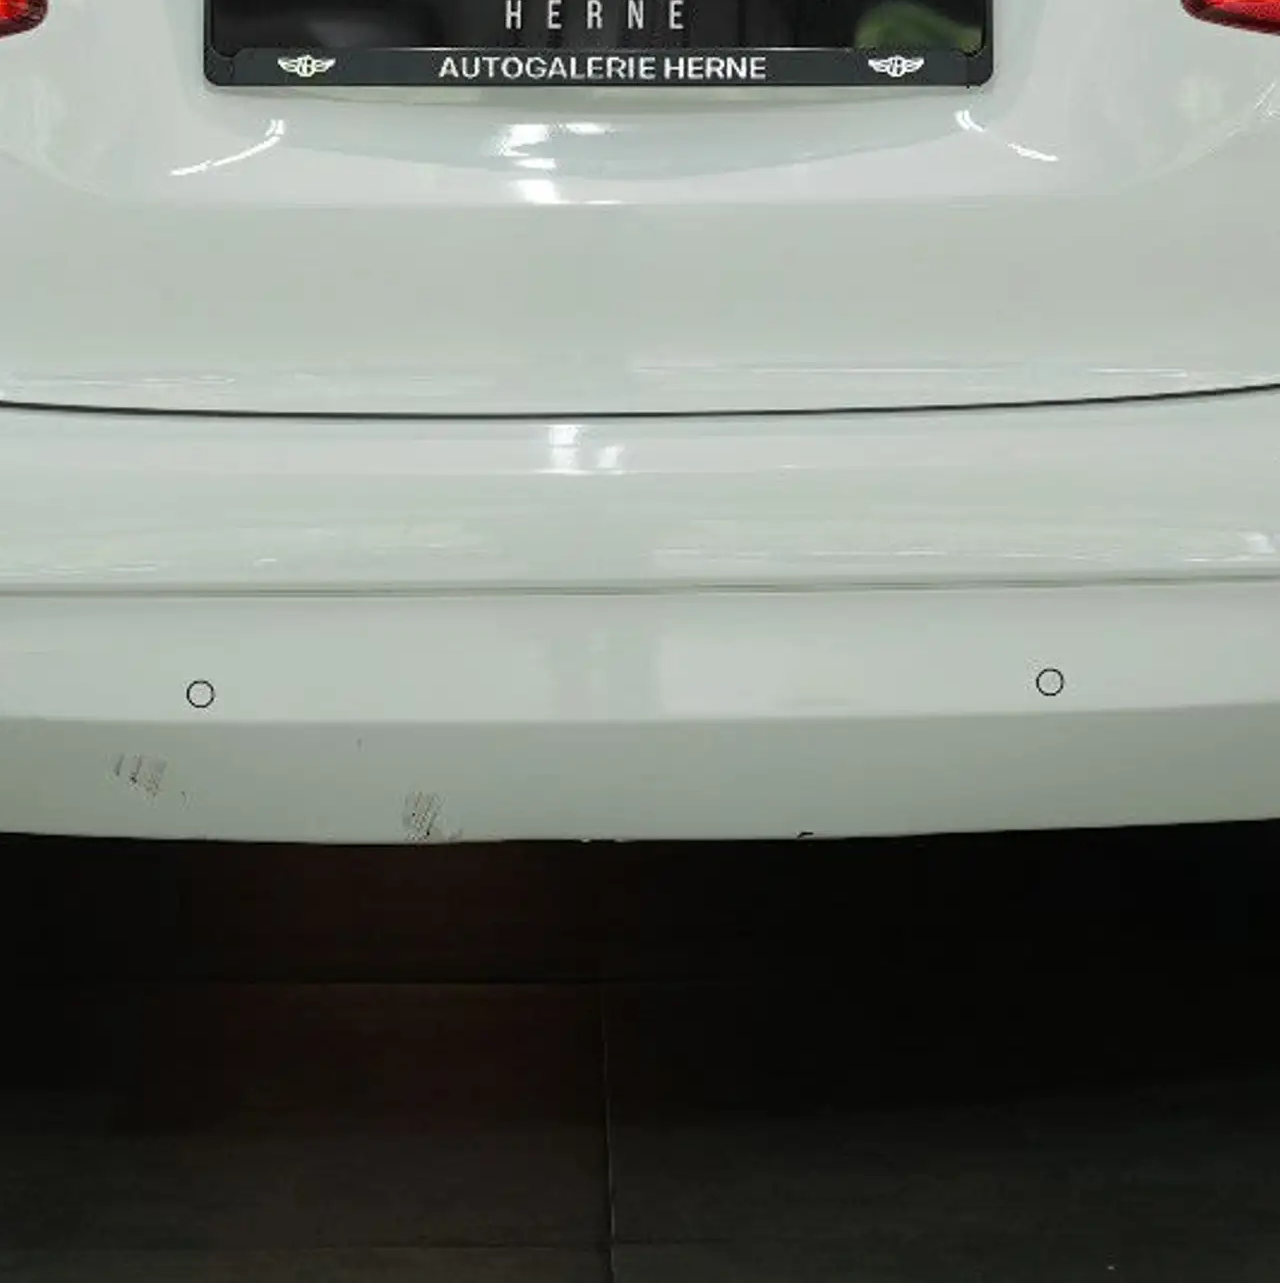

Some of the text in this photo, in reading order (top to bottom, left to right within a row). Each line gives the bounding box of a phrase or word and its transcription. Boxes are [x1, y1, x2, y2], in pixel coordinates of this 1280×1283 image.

[505, 0, 684, 30] HERNE
[438, 56, 767, 79] AUTOGALERIE HERNE
